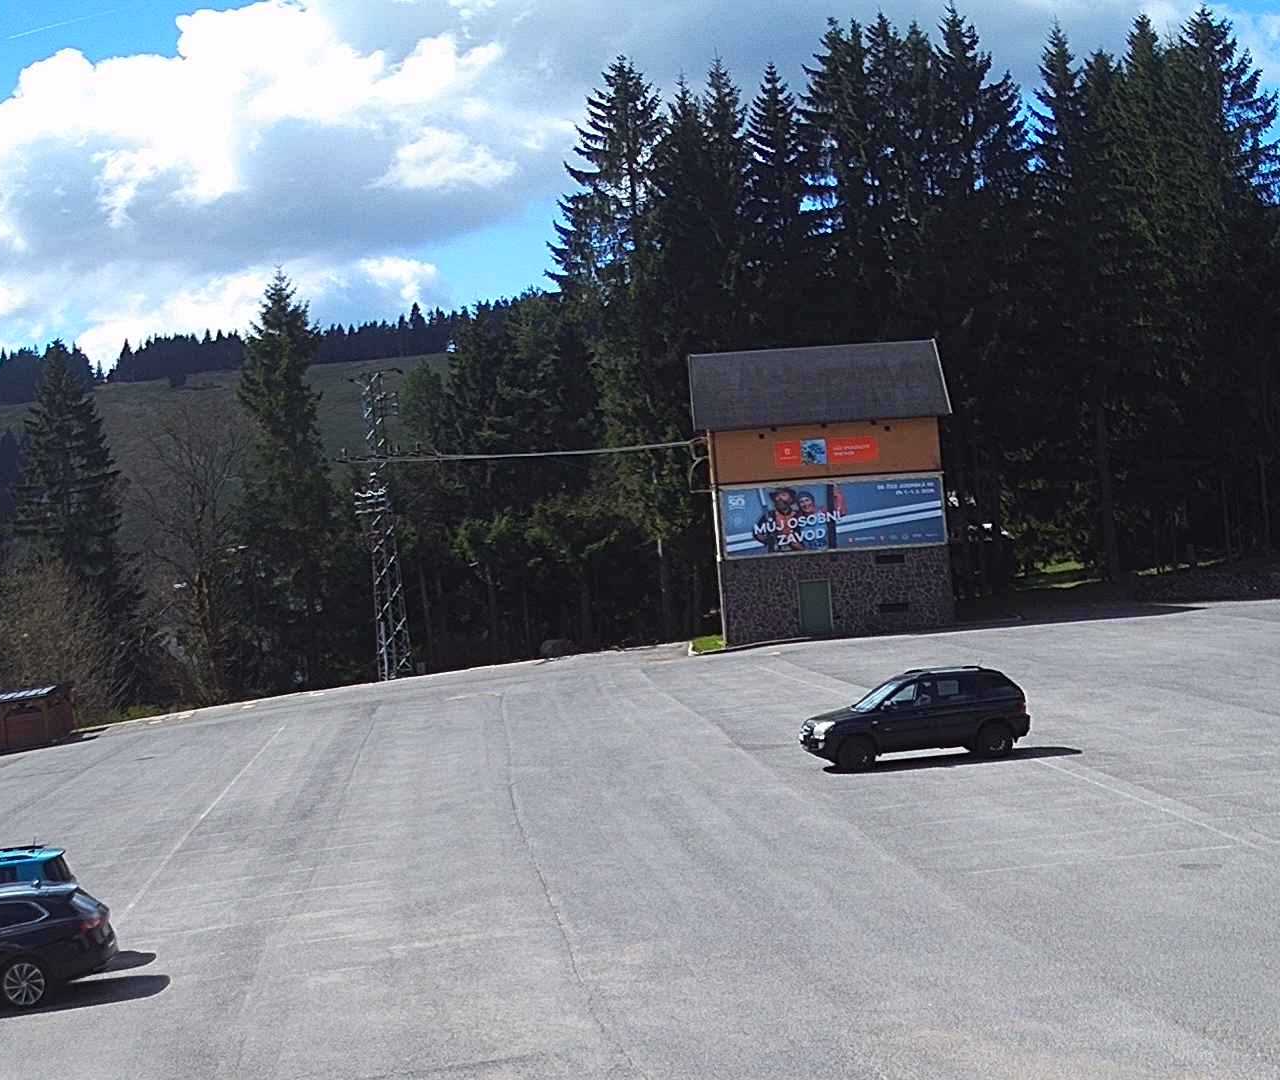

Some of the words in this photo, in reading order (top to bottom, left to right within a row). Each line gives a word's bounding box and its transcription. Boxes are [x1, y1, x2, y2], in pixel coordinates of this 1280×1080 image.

[753, 517, 786, 536] MŮJ
[787, 510, 844, 529] OSOBNÍ
[777, 528, 825, 547] ZÁVOD
